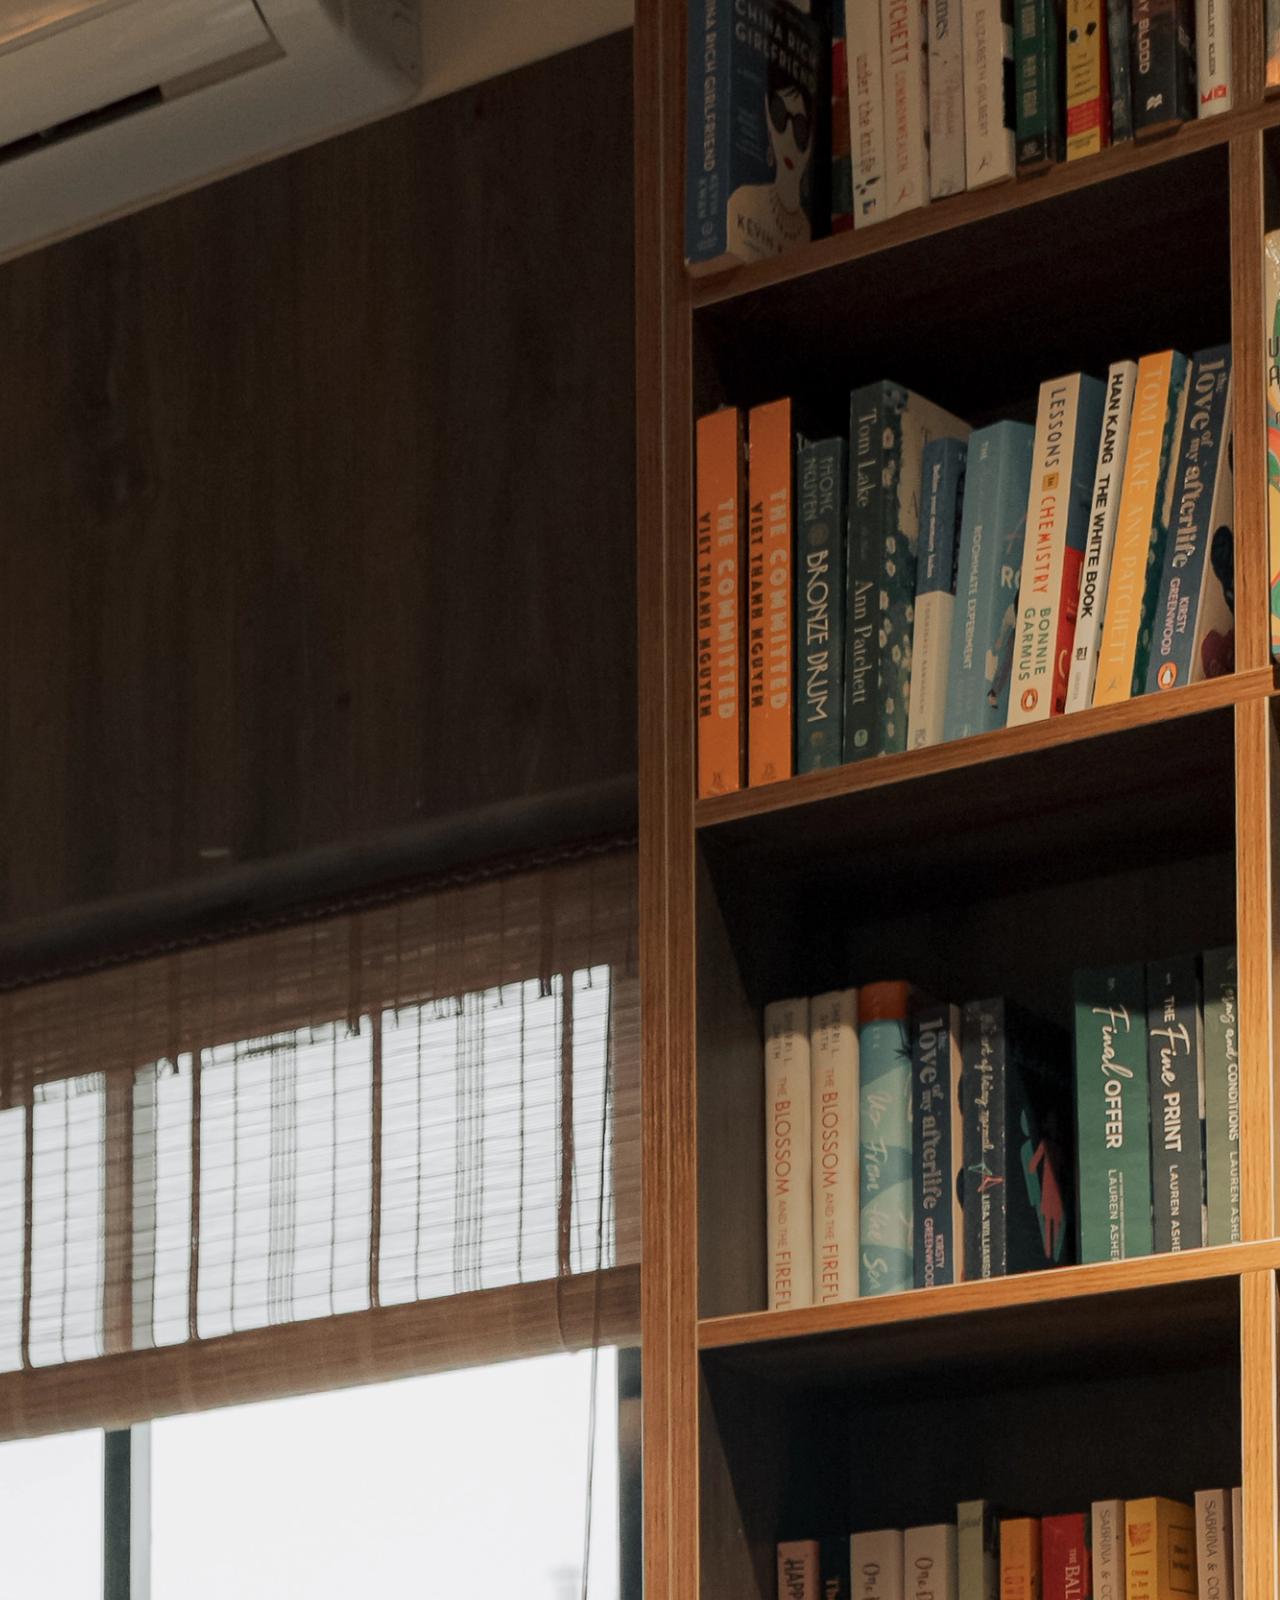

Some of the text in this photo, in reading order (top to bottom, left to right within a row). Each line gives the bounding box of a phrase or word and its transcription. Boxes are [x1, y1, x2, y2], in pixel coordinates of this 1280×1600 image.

[852, 407, 880, 705] Tom Lake Ann Patchett
[1032, 387, 1066, 594] LESSONS CHEMISTRY
[1081, 373, 1124, 619] HAN KANG THE WHITE BOOK
[807, 550, 829, 723] BRONZE DRUM
[1019, 607, 1036, 681] GARMUS
[1035, 607, 1052, 675] BONNIE
[822, 1091, 839, 1188] BLOSSOM
[1092, 1003, 1134, 1220] Final OFFER LAUREN
[1163, 1091, 1181, 1153] PRINT
